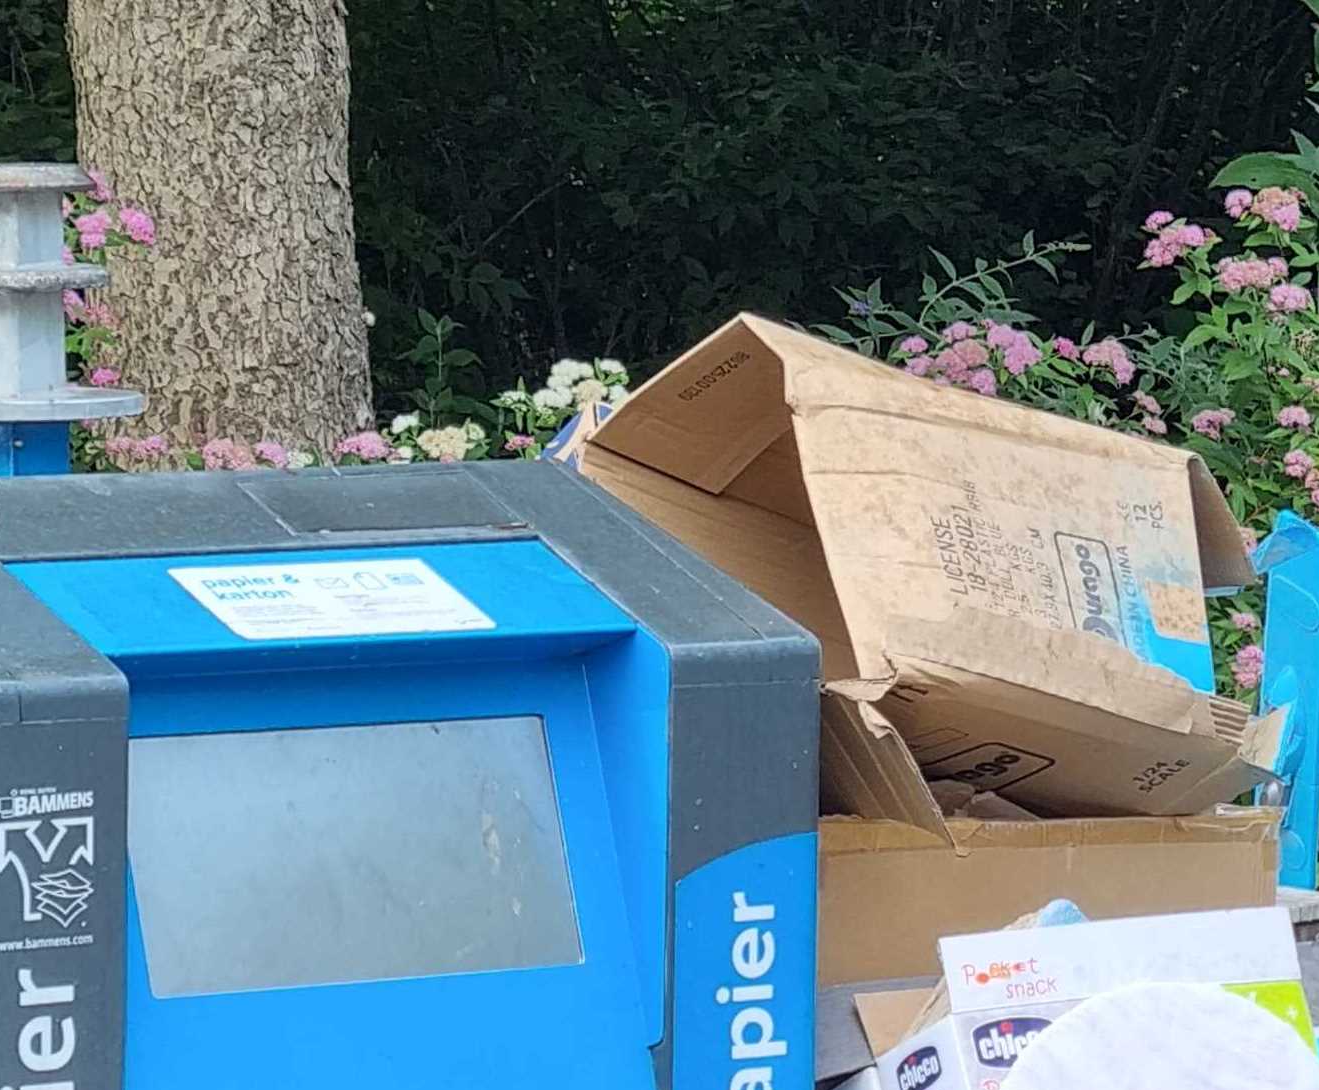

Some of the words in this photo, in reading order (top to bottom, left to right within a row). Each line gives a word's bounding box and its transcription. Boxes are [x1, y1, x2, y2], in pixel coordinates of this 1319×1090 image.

[1133, 504, 1146, 521] 12
[951, 504, 988, 592] 18-28021
[1027, 526, 1044, 549] CM
[930, 515, 968, 596] LICENSE
[201, 575, 275, 591] papier
[282, 574, 300, 585] &
[1117, 546, 1138, 598] CHINA
[214, 588, 294, 601] karton
[1137, 759, 1192, 794] SCALE
[13, 791, 94, 816] BAMMENS
[1006, 978, 1058, 999] snack
[900, 1055, 939, 1090] chicco
